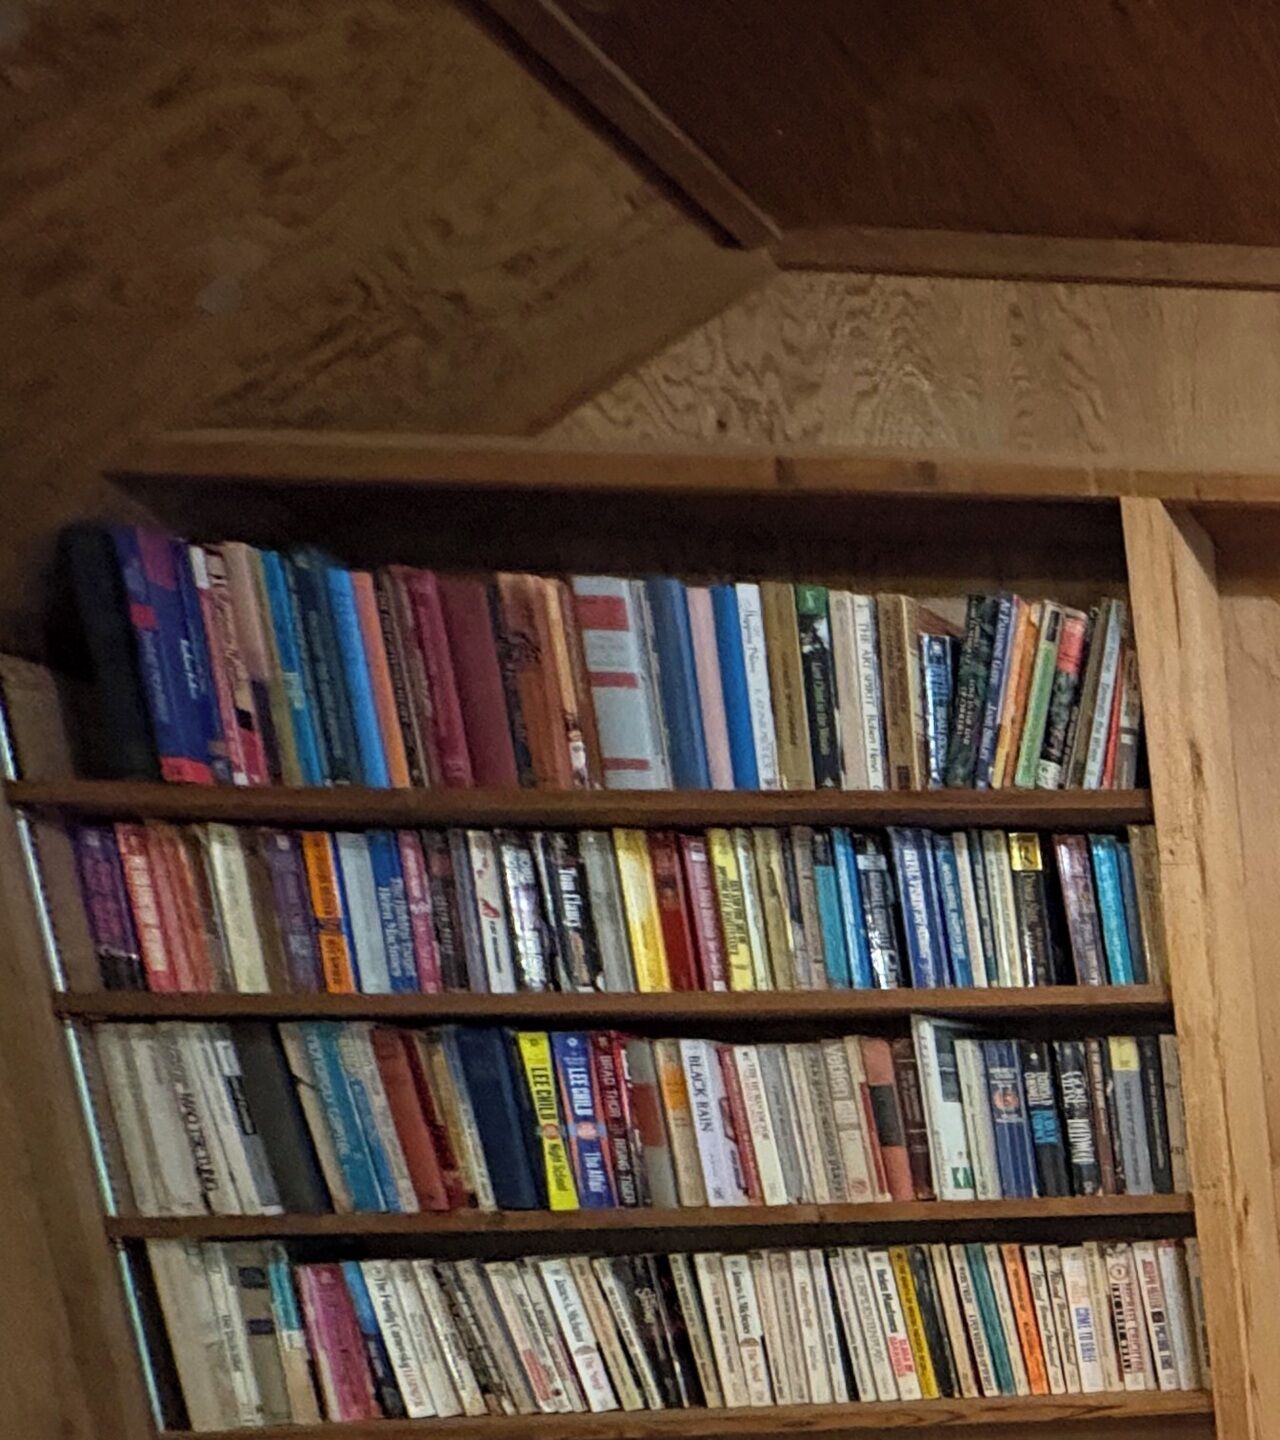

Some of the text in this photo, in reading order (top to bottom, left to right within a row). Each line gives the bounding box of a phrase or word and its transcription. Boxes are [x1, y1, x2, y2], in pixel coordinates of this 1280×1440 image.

[558, 868, 583, 927] Tom Clancy
[531, 1066, 557, 1120] LEE CHILD
[568, 1067, 593, 1116] LEE CHILD
[600, 1055, 620, 1118] BRAD THOR
[688, 1056, 712, 1132] BLACK RAIN
[824, 1044, 851, 1098] Veblen
[1079, 1332, 1093, 1341] TO
